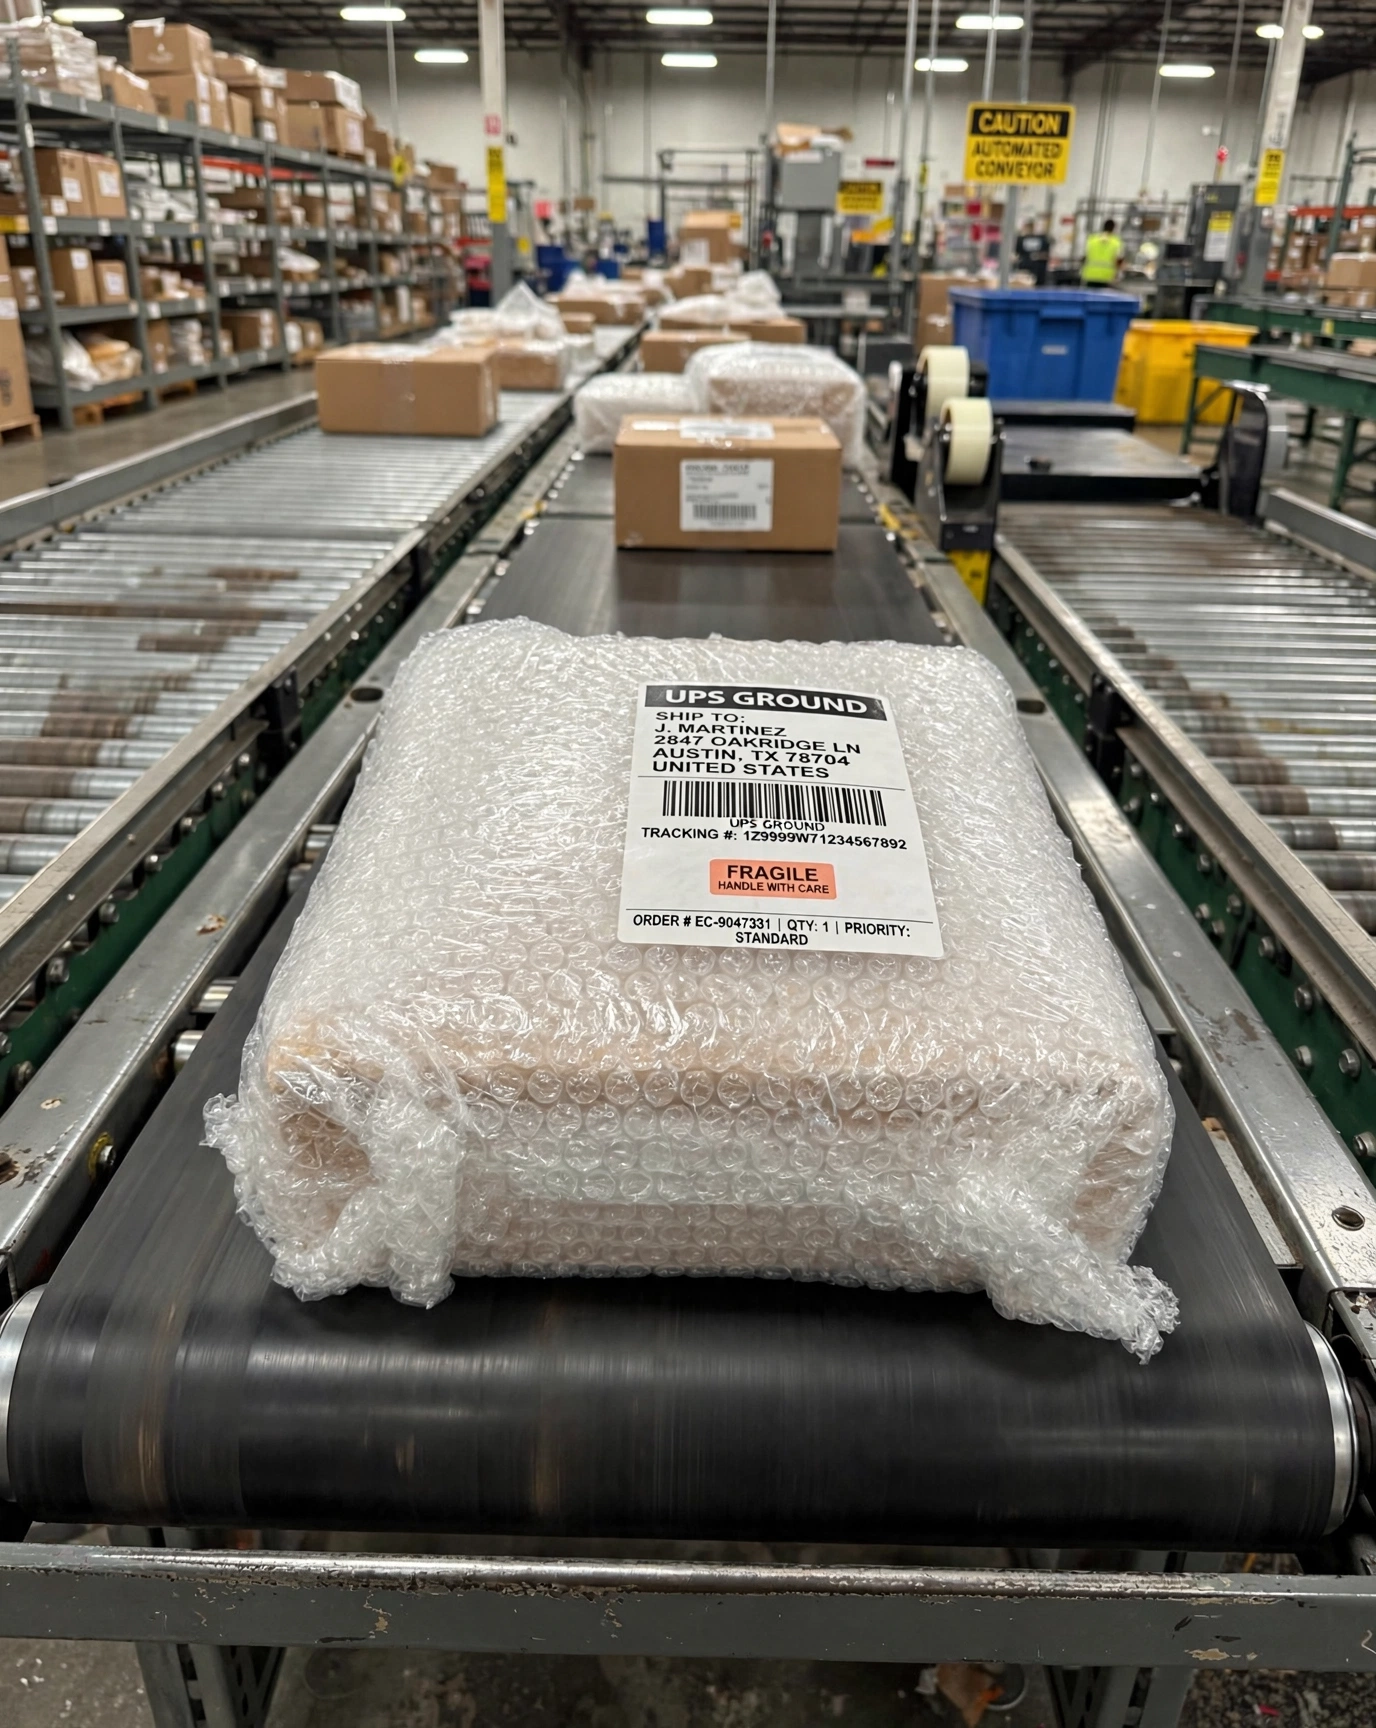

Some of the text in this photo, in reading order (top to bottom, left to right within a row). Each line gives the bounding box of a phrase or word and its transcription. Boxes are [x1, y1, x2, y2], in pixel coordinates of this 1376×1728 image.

[978, 111, 1061, 135] CAUTION
[972, 140, 1062, 159] AUTOMATED
[975, 160, 1055, 179] CONVEYOR
[665, 689, 868, 714] UPS GROUND
[655, 711, 745, 723] SHIP TO:
[654, 723, 787, 737] J. MARTINEZ
[654, 735, 861, 754] 2847 OAKRIDGE LN
[652, 747, 851, 767] AUSTIN, TX 78704
[652, 761, 830, 779] UNITED STATES
[729, 818, 825, 832] UPS GROUND
[641, 827, 908, 850] TRACKING #: 1Z9999W71234567892
[727, 864, 819, 882] FRAGILE
[718, 881, 830, 894] HANDLE WITH CARE
[633, 914, 680, 927] ORDER
[683, 915, 692, 928] #
[695, 915, 770, 930] EC-9047331
[787, 918, 818, 932] QTY:
[822, 921, 829, 933] 1
[844, 921, 911, 938] PRIORITY:
[735, 931, 809, 946] STANDARD
